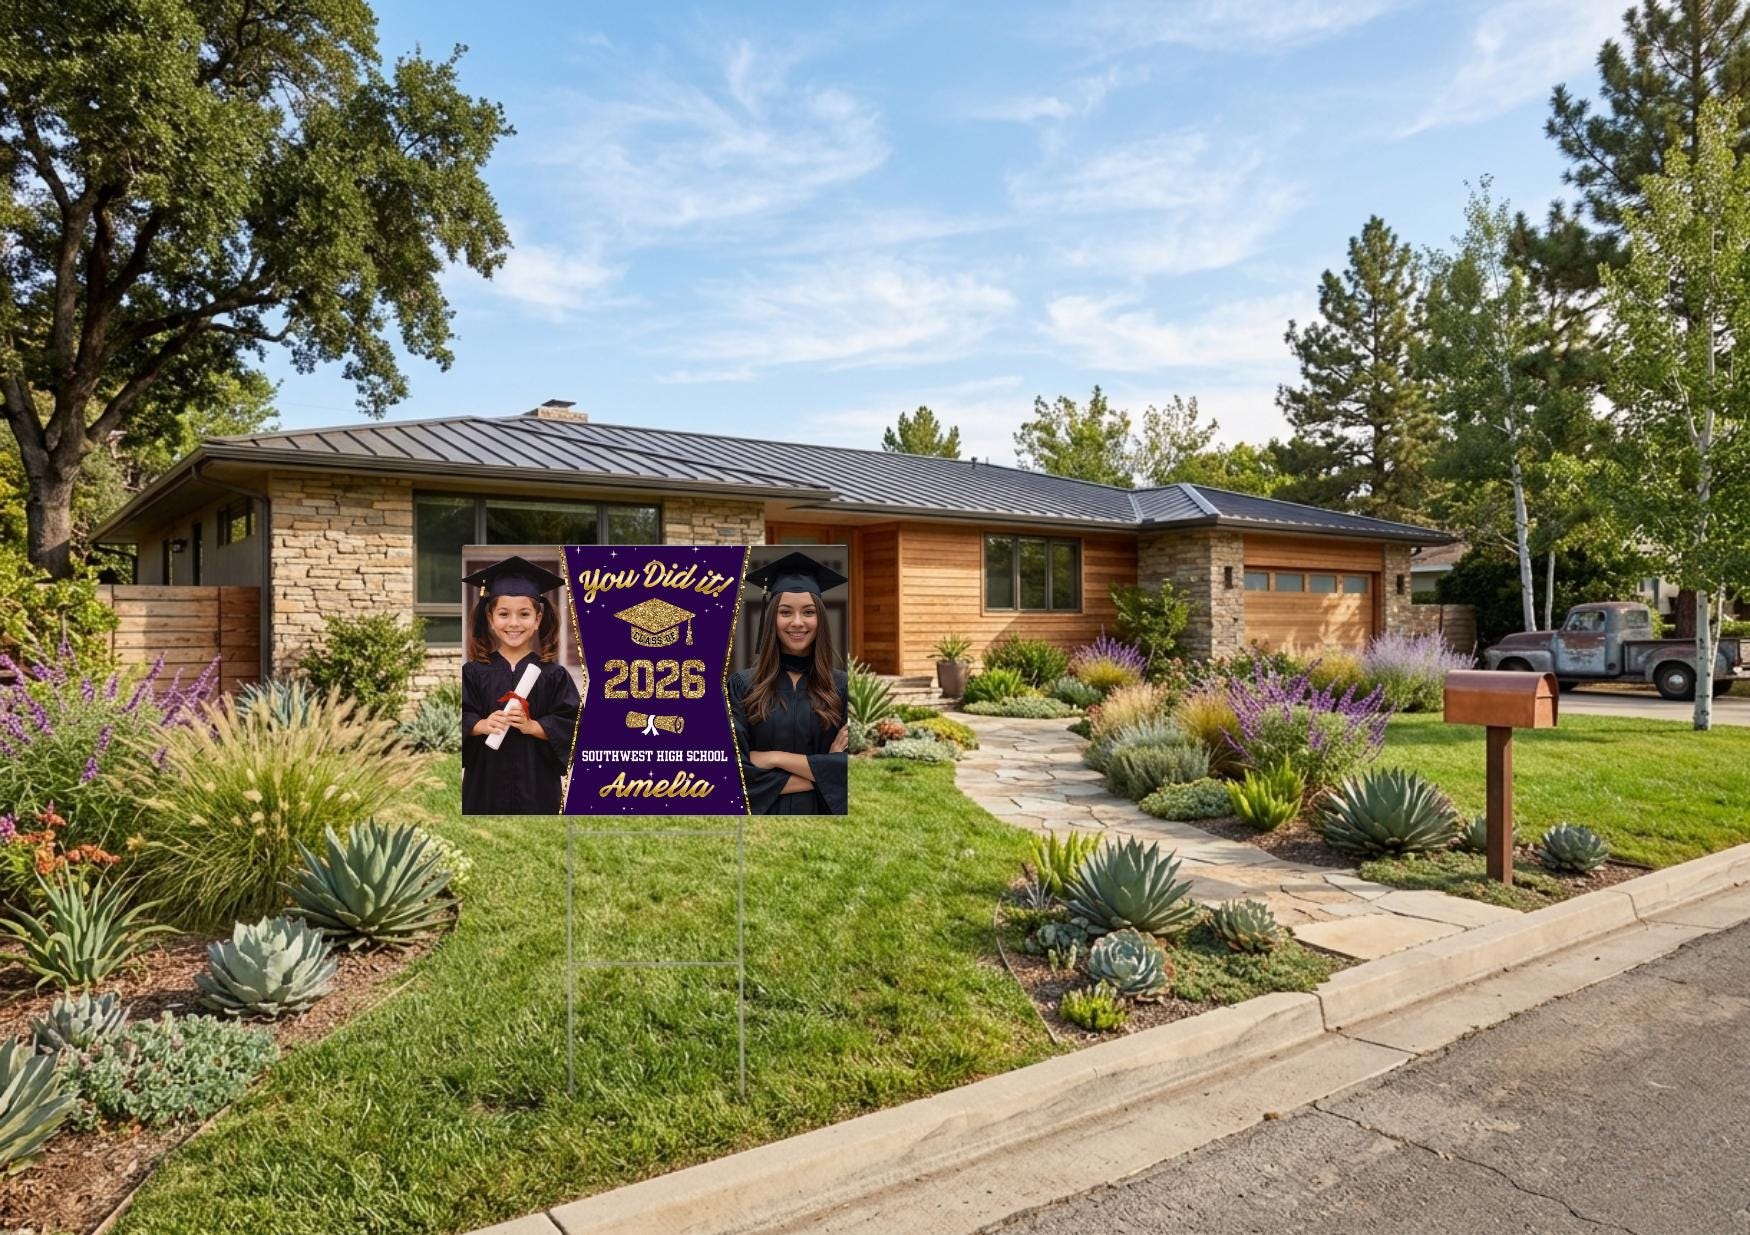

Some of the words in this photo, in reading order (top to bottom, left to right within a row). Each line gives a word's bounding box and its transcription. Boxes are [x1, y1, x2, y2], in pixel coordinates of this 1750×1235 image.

[643, 560, 698, 589] Did
[694, 569, 735, 598] it!
[633, 631, 662, 645] CLASS
[665, 631, 676, 643] OF
[604, 659, 706, 699] 2026
[581, 750, 653, 762] SOUTHWEST
[656, 750, 683, 762] HIGH
[686, 750, 728, 762] SCHOOL
[599, 770, 715, 798] Amelia
